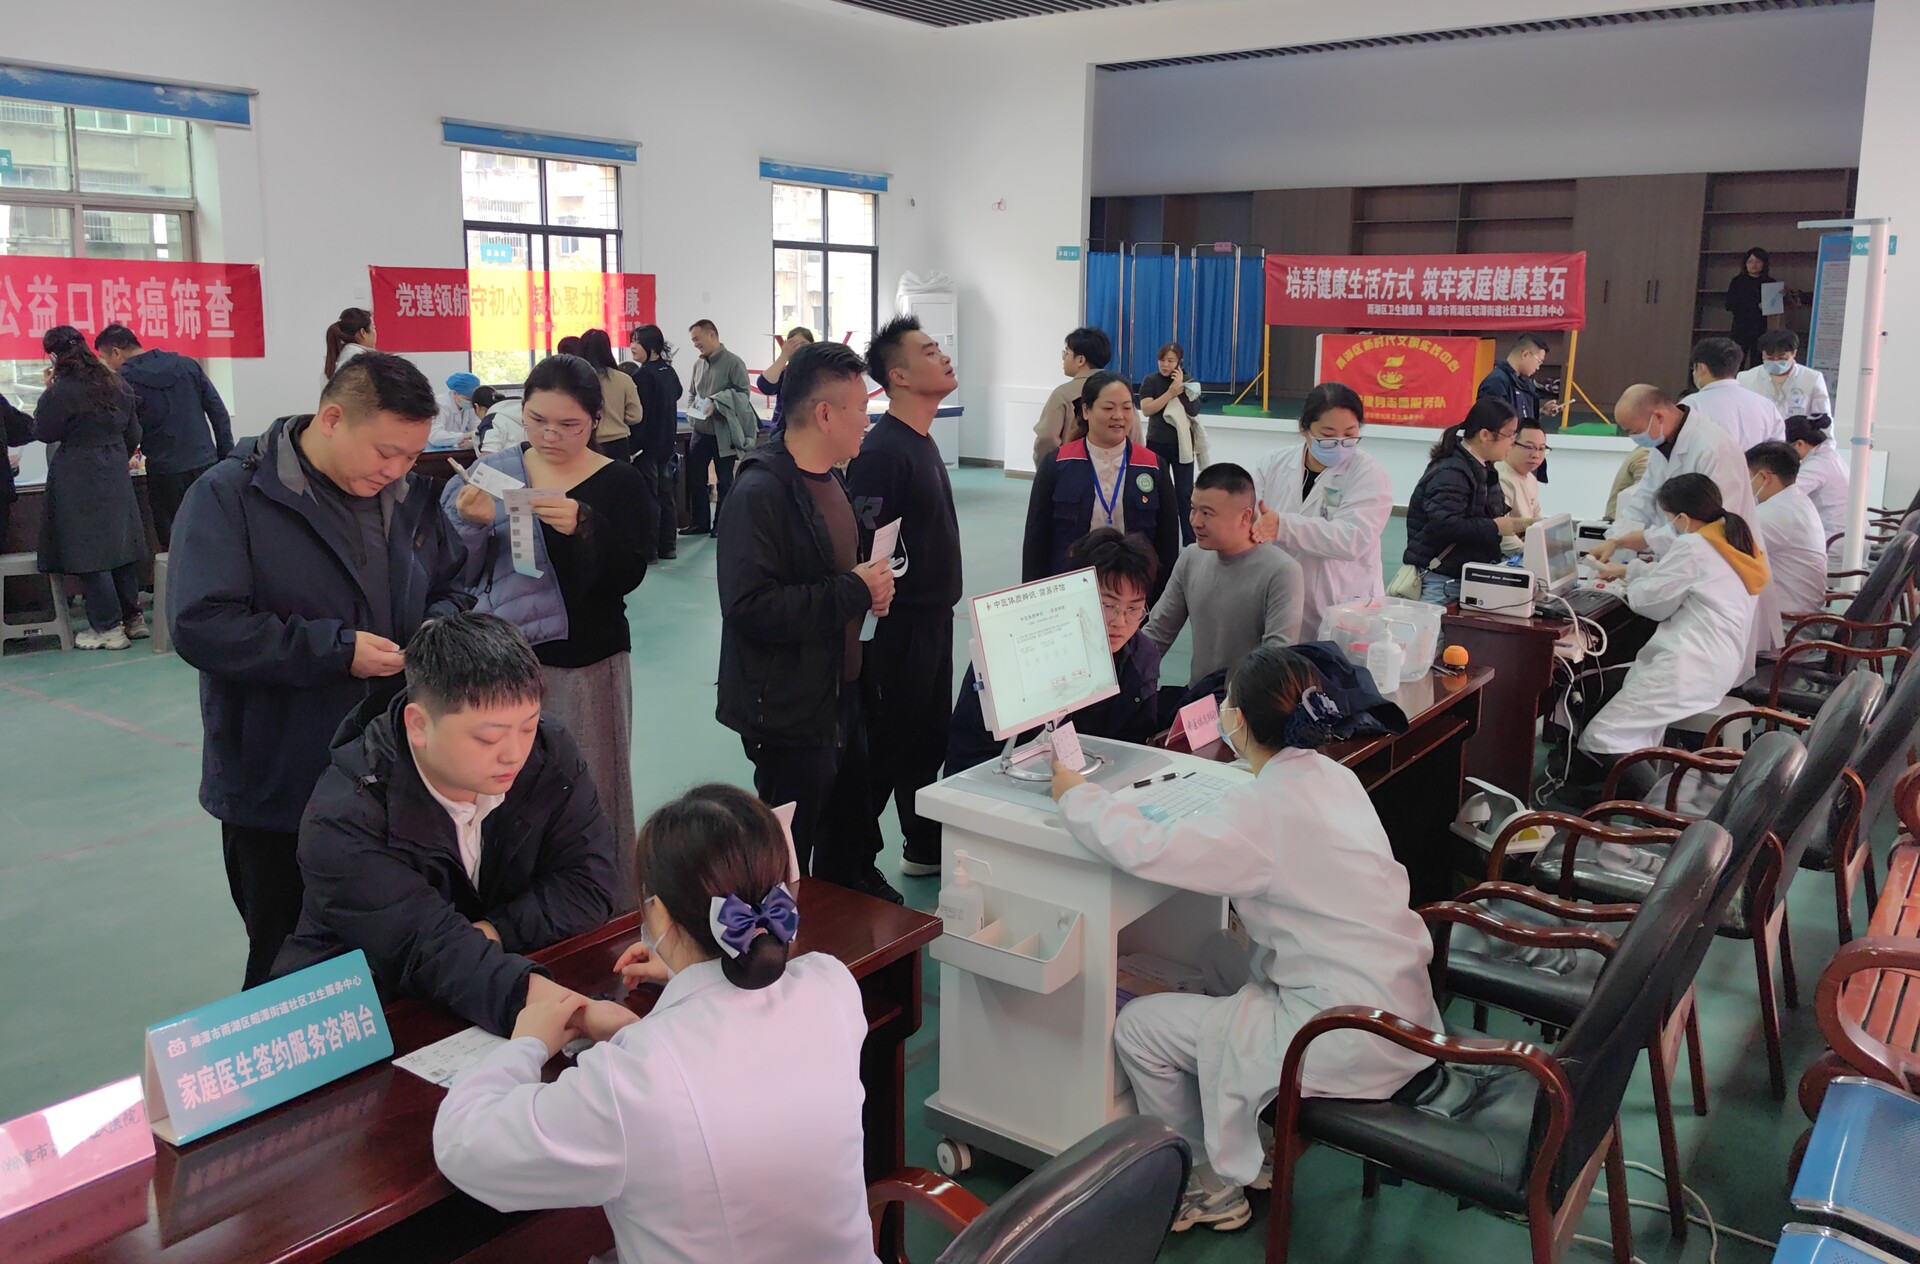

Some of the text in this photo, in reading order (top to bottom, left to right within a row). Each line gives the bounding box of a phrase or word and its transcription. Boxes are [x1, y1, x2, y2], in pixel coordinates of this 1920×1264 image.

[0, 274, 235, 340] 公益口腔癌筛查
[395, 283, 523, 318] 党建领航守初心
[1286, 266, 1568, 301] 培养健康生活方式 筑牢家庭健康基石
[1367, 303, 1423, 316] 雨湖区卫生健康局
[190, 975, 362, 1049] 湘潭市雨湖区昭潭街道社区卫生服务中心
[177, 1004, 377, 1110] 家庭医生签约服务咨询台
